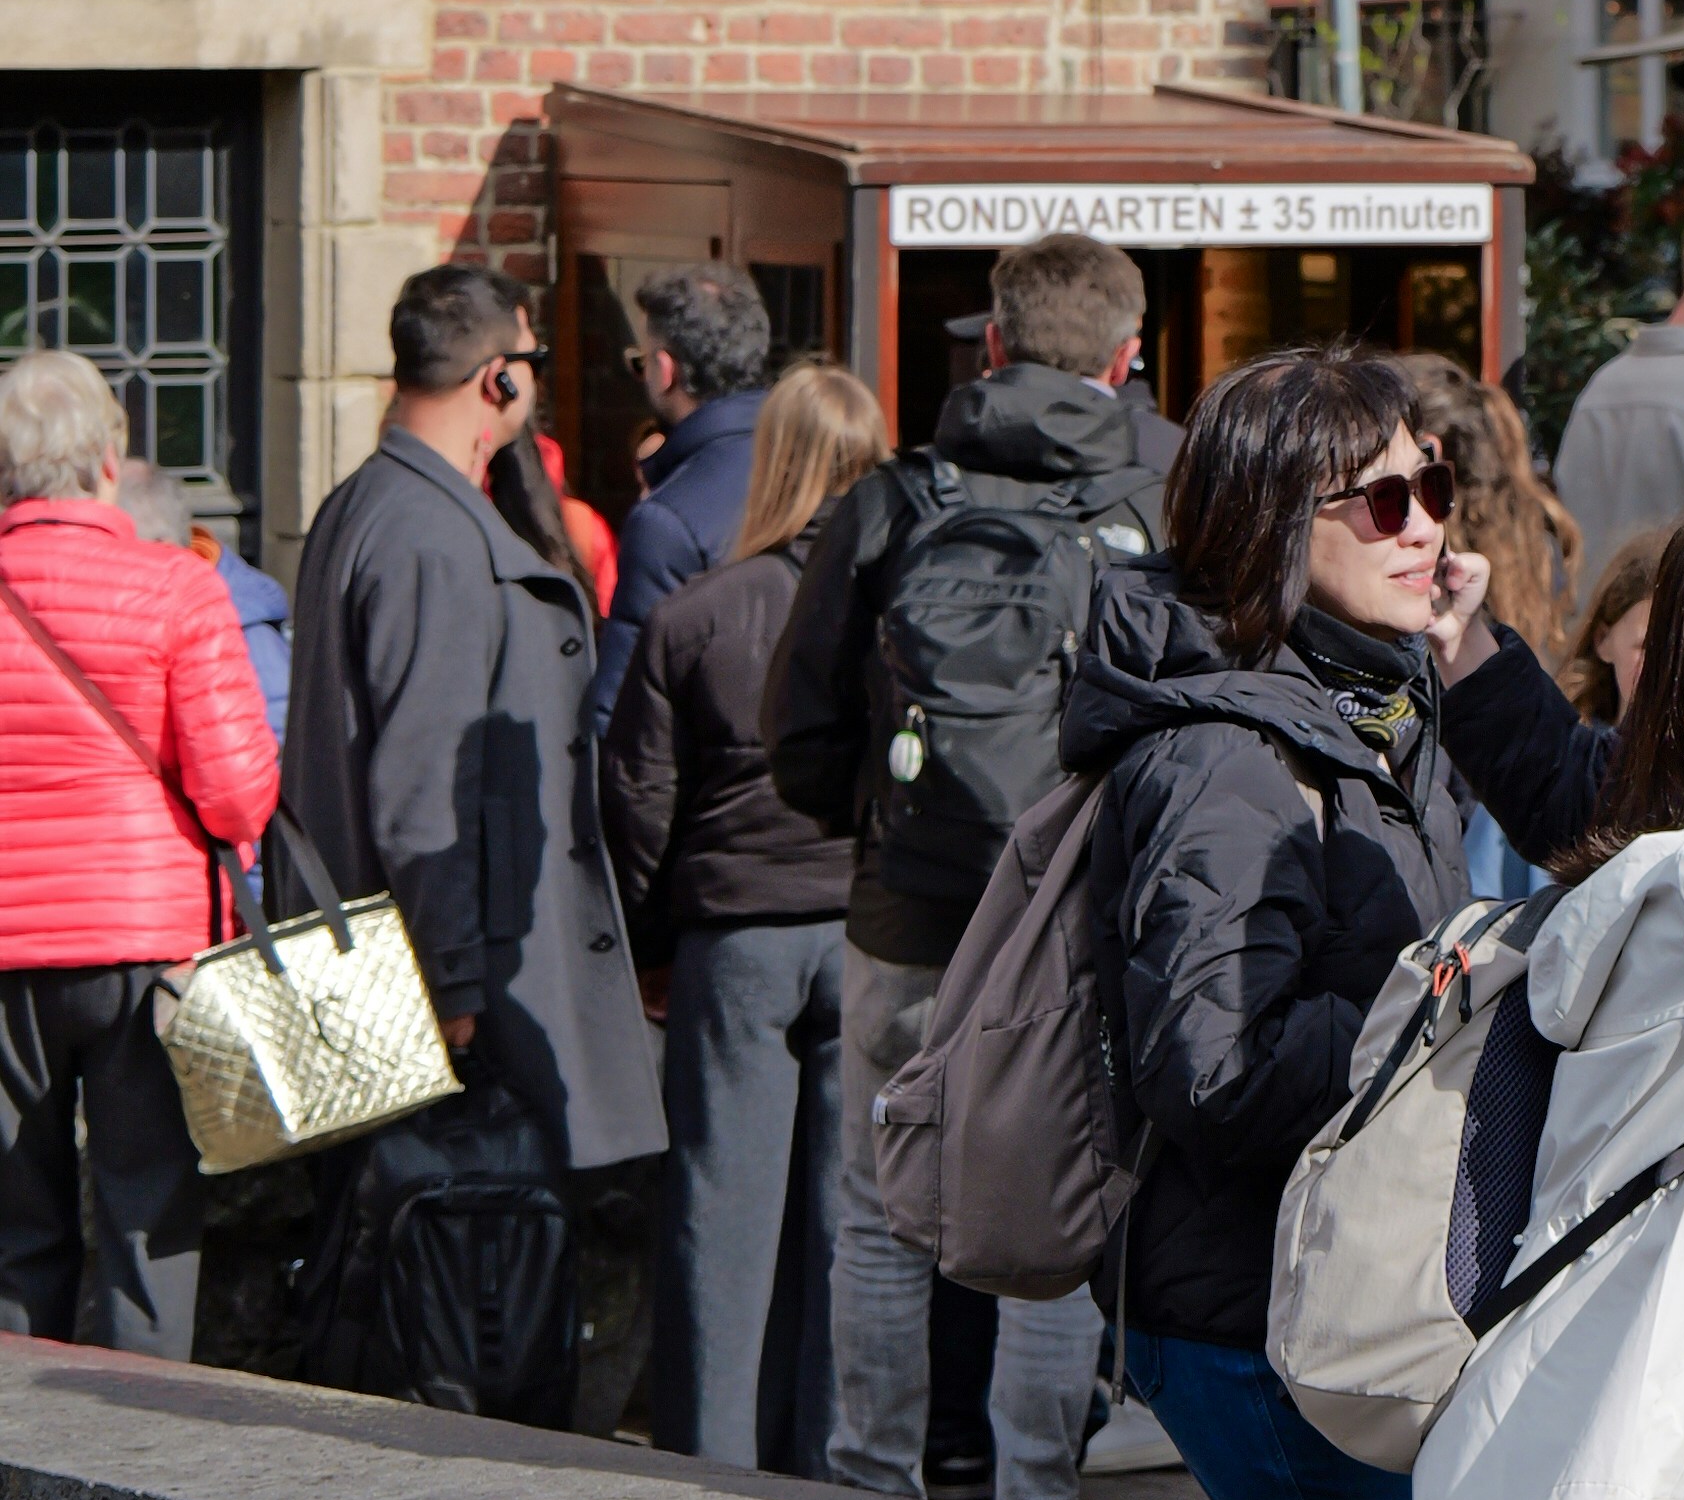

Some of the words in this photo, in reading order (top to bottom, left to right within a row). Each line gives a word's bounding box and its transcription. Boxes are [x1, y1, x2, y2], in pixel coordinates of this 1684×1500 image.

[907, 196, 1224, 233] RONDVAARTEN
[1239, 198, 1259, 231] ±
[1273, 196, 1315, 232] 35
[1329, 195, 1480, 232] minuten
